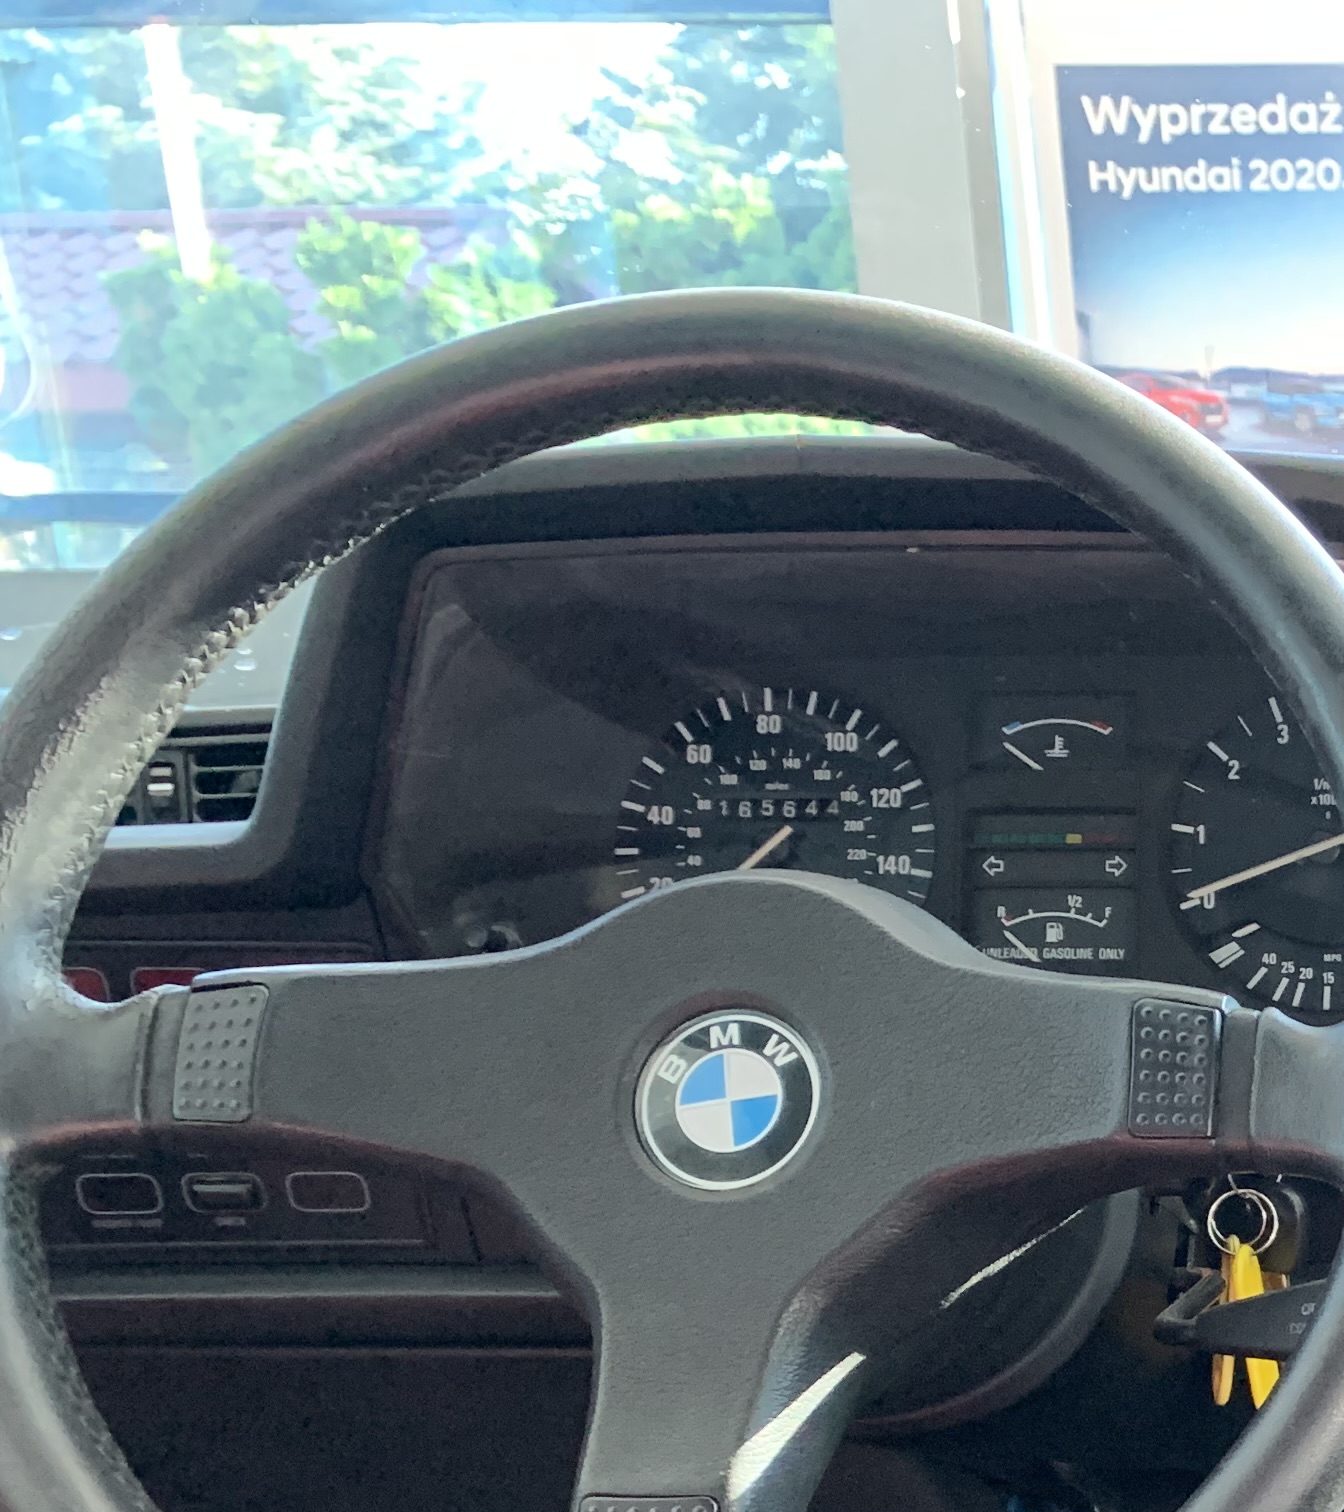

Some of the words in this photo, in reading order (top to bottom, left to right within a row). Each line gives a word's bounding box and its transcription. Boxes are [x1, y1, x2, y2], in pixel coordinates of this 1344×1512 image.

[1080, 91, 1344, 144] Wyprzedaż
[1087, 157, 1242, 200] Hyundai
[756, 714, 781, 734] 80
[1276, 724, 1290, 744] 3
[824, 732, 858, 752] 100
[686, 744, 713, 764] 60
[1227, 759, 1241, 780] 2
[870, 788, 902, 808] 120
[646, 805, 674, 825] 40
[1196, 824, 1205, 845] 1
[876, 855, 910, 875] 140
[1042, 947, 1094, 960] GASOLINE
[1098, 948, 1126, 960] ONLY
[1261, 953, 1277, 965] 40
[1280, 961, 1295, 974] 25
[1298, 967, 1314, 980] 20
[1322, 971, 1335, 984] 15
[656, 1022, 799, 1085] BMW
